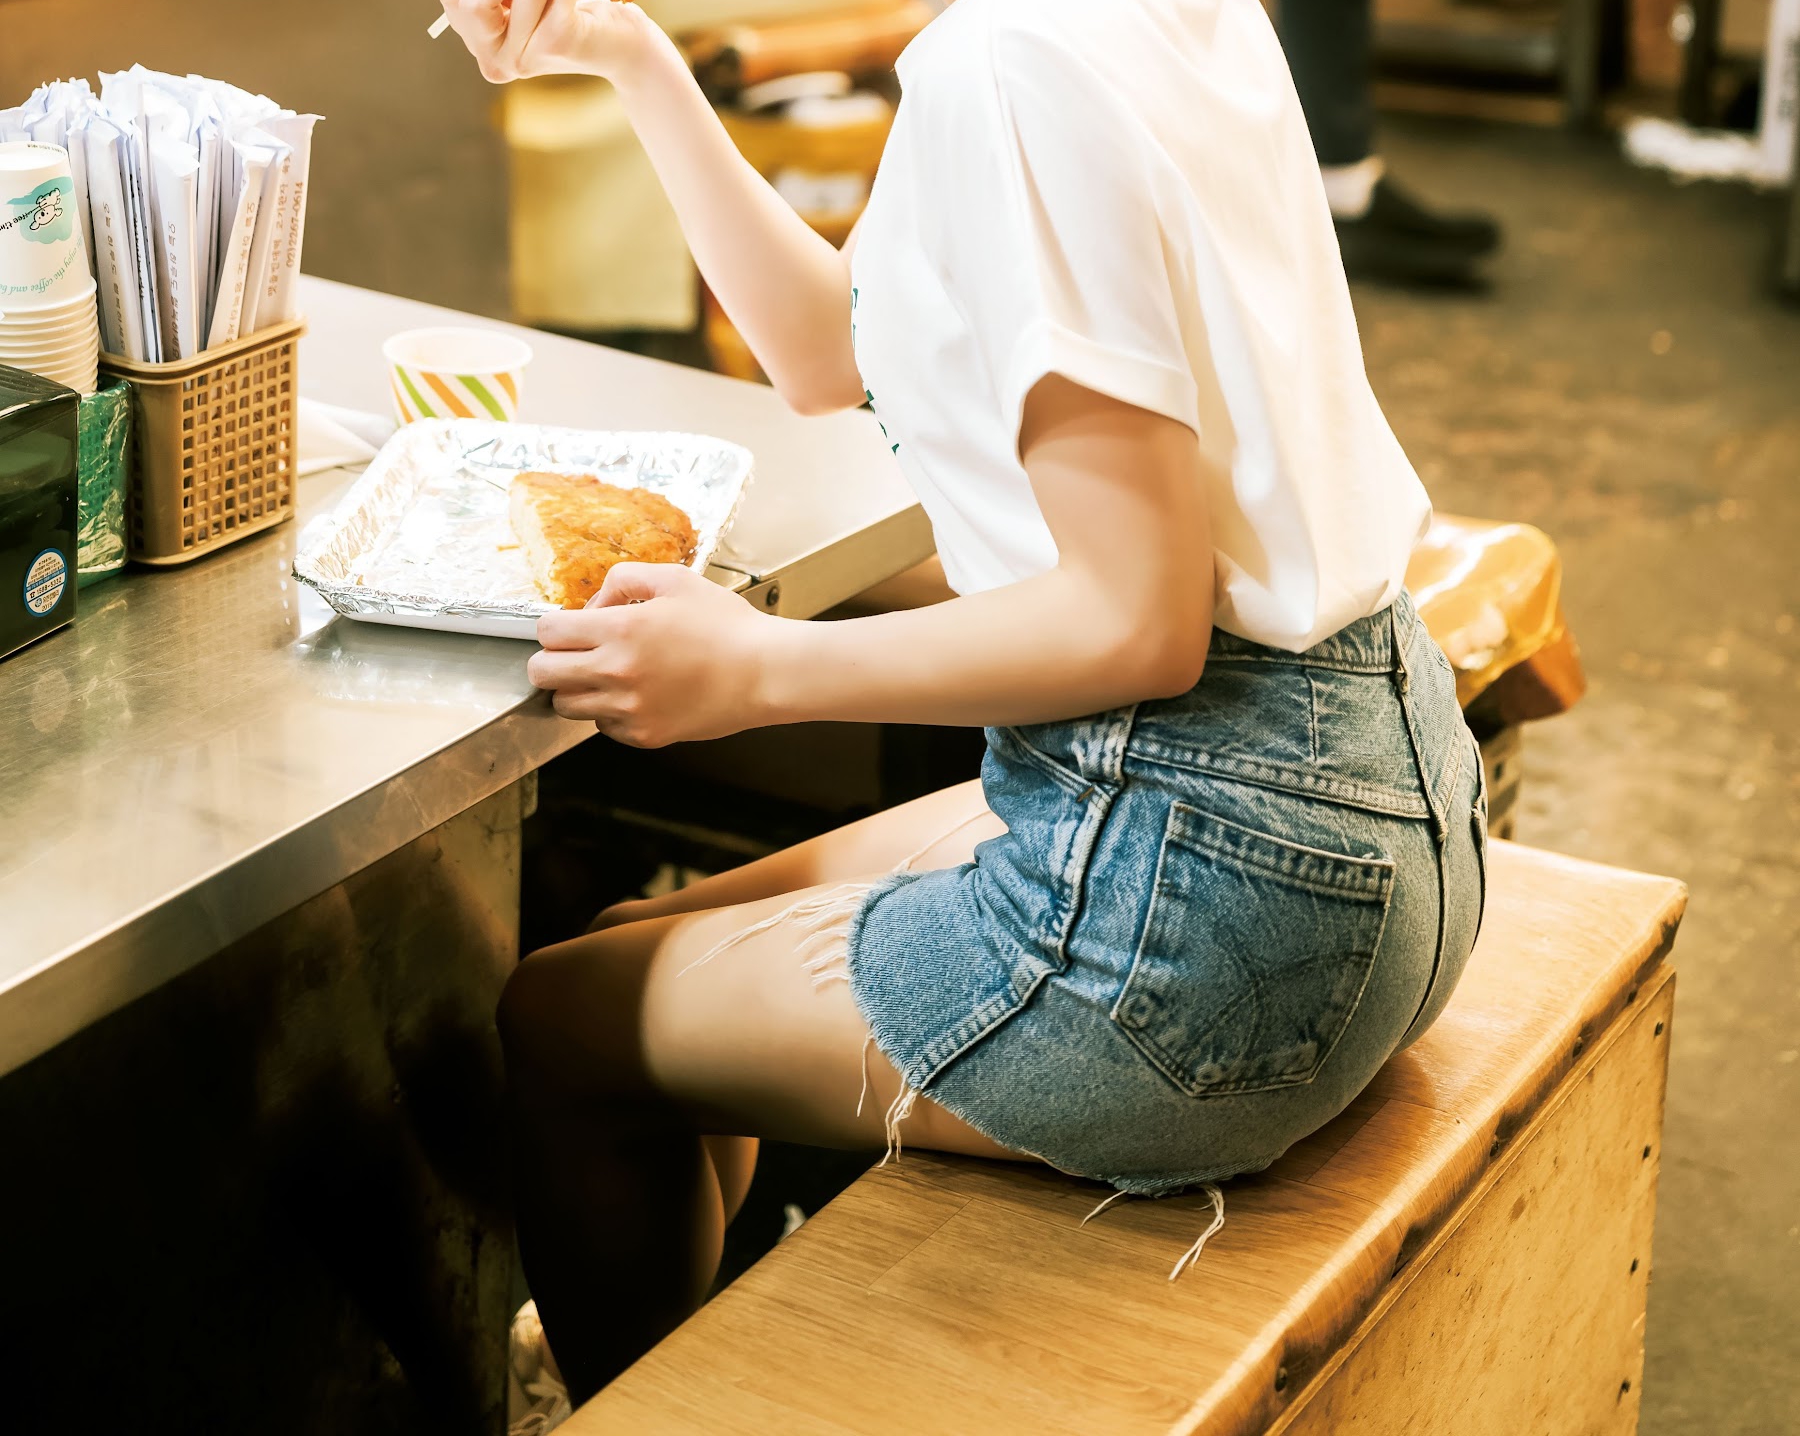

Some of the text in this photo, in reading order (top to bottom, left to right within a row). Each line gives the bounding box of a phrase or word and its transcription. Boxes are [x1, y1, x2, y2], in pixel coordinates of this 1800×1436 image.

[167, 220, 176, 247] 오늘
[286, 181, 303, 269] 02)2267-0614
[54, 268, 65, 280] the
[170, 252, 178, 291] 하루도
[8, 286, 27, 296] and
[31, 277, 53, 293] coffee
